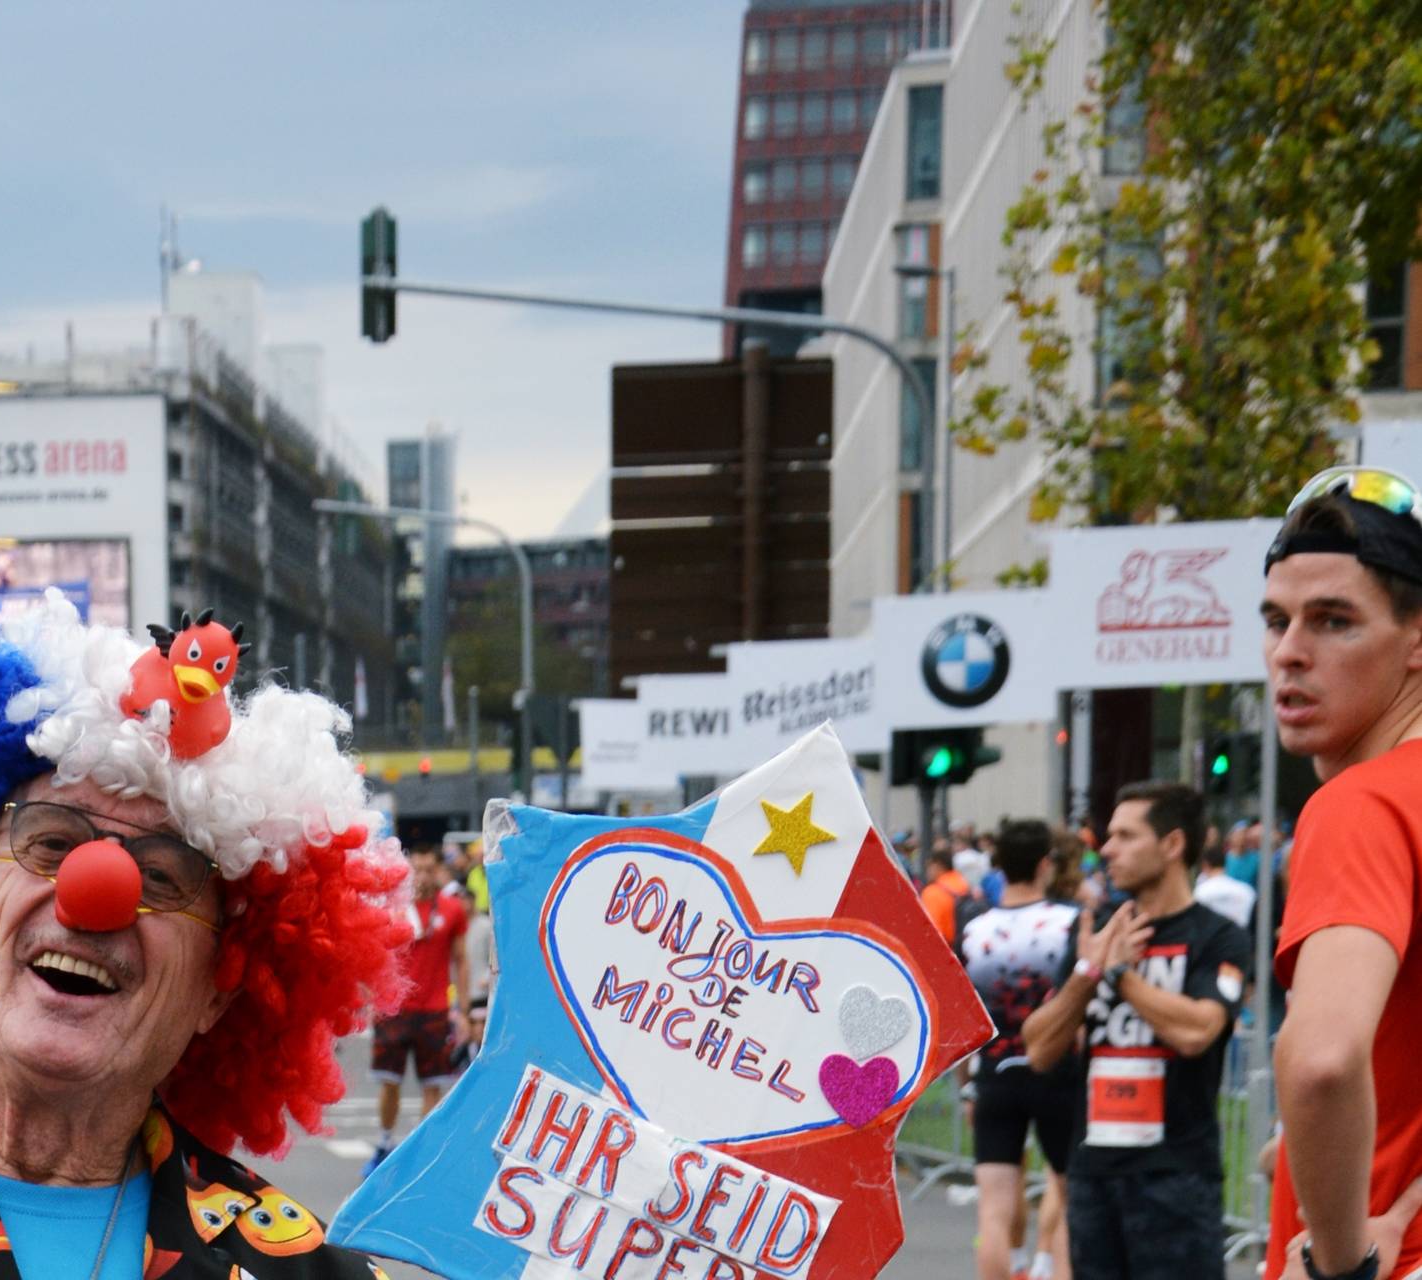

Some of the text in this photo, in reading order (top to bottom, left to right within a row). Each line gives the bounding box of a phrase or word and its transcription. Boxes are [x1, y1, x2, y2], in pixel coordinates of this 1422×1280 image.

[44, 440, 127, 474] arena
[1096, 635, 1231, 663] GENERALI
[605, 862, 820, 1013] BONJOUR
[689, 973, 749, 1018] DE
